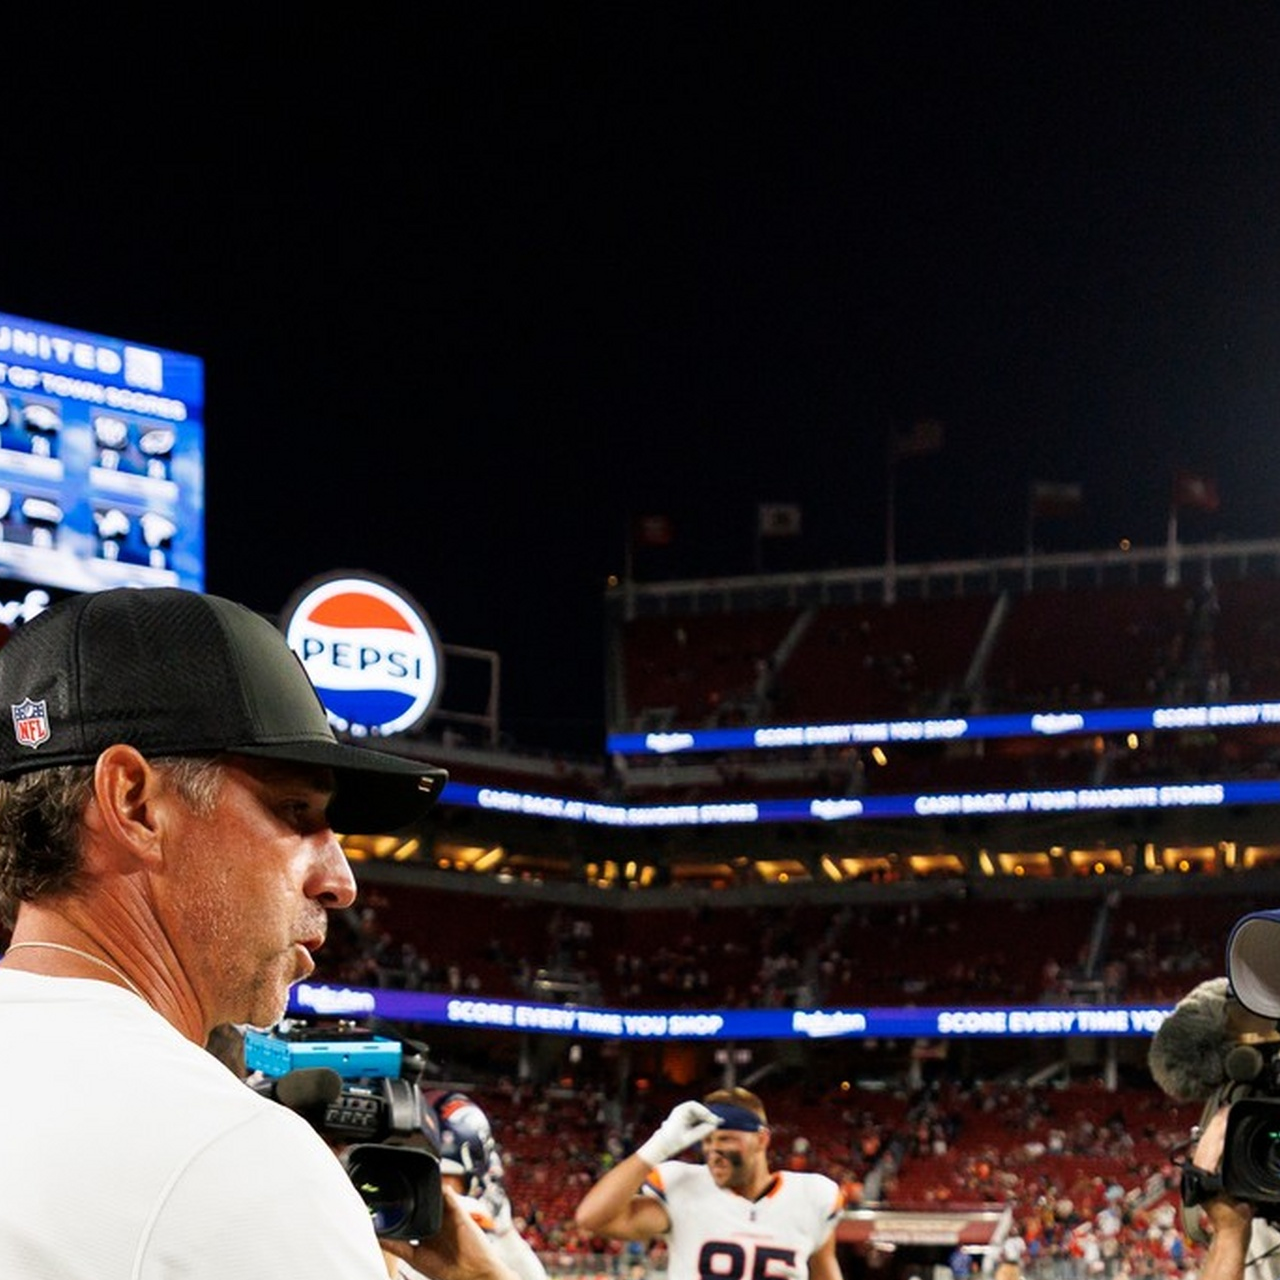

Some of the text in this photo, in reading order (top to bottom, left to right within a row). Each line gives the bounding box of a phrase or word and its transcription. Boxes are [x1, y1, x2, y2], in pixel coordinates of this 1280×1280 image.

[303, 637, 421, 680] PEPSI
[19, 719, 46, 741] NFL
[447, 1000, 514, 1026] SCORE
[578, 1011, 622, 1035] TIME
[623, 1015, 667, 1036] YOU
[668, 1015, 723, 1036] SHOP
[937, 1012, 1007, 1033] SCORE
[1009, 1010, 1076, 1033] EVERY
[1077, 1010, 1128, 1032] TIME
